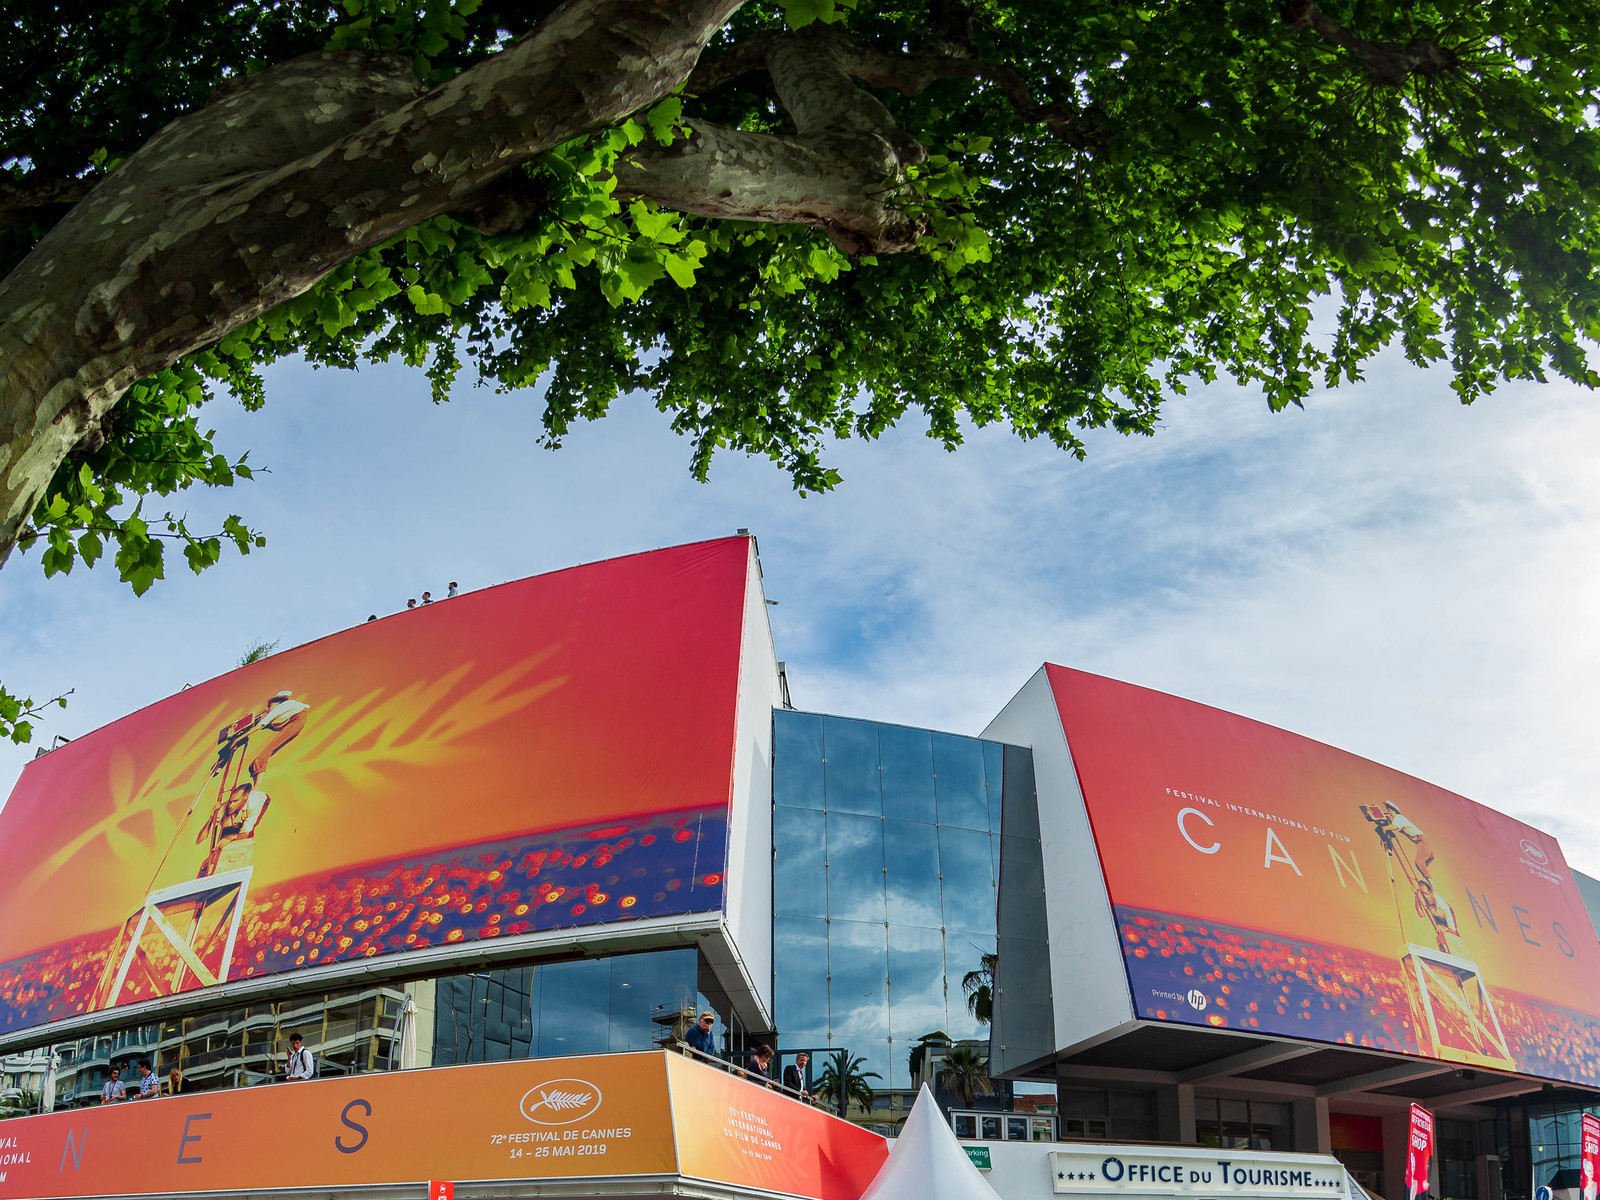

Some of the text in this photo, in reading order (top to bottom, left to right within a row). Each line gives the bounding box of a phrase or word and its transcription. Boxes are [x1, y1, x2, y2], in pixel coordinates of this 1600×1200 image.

[1166, 787, 1351, 843] FESTIVAL INTERNATIONAL DU FILM
[1152, 988, 1176, 1001] Printed
[1176, 992, 1185, 1002] by
[741, 1109, 768, 1126] FESTIVAL
[508, 1131, 560, 1143] FESTIVAL
[563, 1130, 579, 1141] DE
[581, 1127, 632, 1140] CANNES
[728, 1117, 773, 1138] INTERNATIONAL
[735, 1130, 749, 1142] FILM
[750, 1135, 759, 1144] DE
[760, 1138, 782, 1151] CANNES
[1412, 1134, 1427, 1151] SHOP
[1584, 1141, 1599, 1155] SHOP
[510, 1148, 523, 1159] 14
[534, 1146, 550, 1158] 25
[552, 1145, 575, 1157] MAI
[577, 1144, 607, 1156] 2019
[965, 1149, 989, 1158] arking
[1102, 1157, 1312, 1187] OFFICE DU TOURISME
